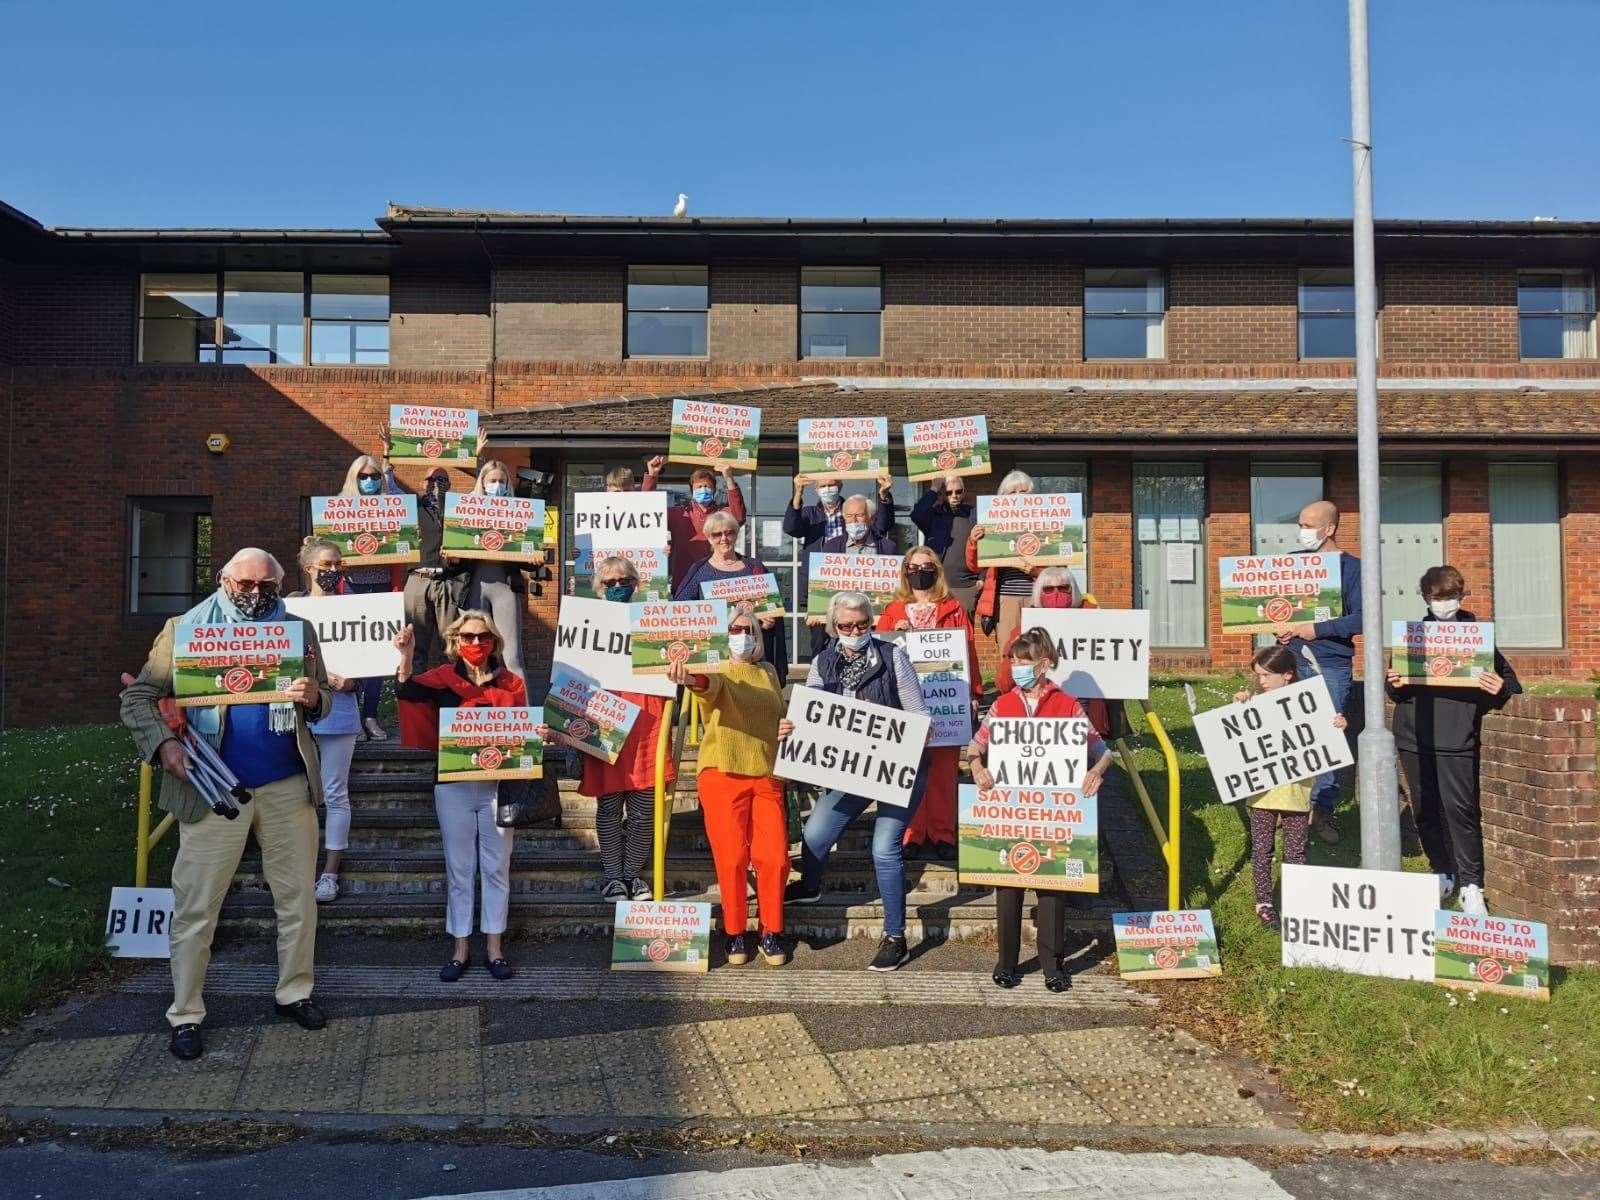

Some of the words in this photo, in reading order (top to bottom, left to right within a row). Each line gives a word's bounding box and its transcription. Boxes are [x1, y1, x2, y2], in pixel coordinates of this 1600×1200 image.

[404, 407, 426, 417] SAY
[430, 409, 447, 418] NO
[451, 410, 466, 419] TO
[687, 403, 709, 412] SAY
[712, 405, 730, 415] NO
[733, 407, 749, 417] TO
[400, 417, 469, 429] MONGEHAM
[681, 413, 752, 428] MONGEHAM
[811, 420, 833, 430] SAY
[838, 420, 855, 429] NO
[860, 419, 874, 428] TO
[916, 423, 937, 433] SAY
[940, 420, 956, 430] NO
[960, 418, 974, 427] TO
[404, 428, 463, 439] AIRFIELD!
[687, 425, 744, 438] AIRFIELD!
[808, 430, 878, 440] MONGEHAM
[912, 428, 979, 443] MONGEHAM
[815, 440, 873, 450] AIRFIELD!
[920, 438, 974, 453] AIRFIELD!
[327, 498, 354, 508] SAY
[360, 497, 379, 507] NO
[384, 497, 402, 506] TO
[460, 496, 486, 505] SAY
[490, 499, 509, 507] NO
[514, 500, 531, 509] TO
[991, 497, 1018, 507] SAY
[1023, 496, 1043, 506] NO
[1048, 495, 1066, 505] TO
[324, 508, 407, 520] MONGEHAM
[455, 506, 534, 520] MONGEHAM
[988, 508, 1072, 519] MONGEHAM
[333, 520, 401, 532] AIRFIELD!
[461, 518, 528, 531] AIRFIELD!
[996, 520, 1065, 532] AIRFIELD!
[588, 550, 612, 559] SAY
[616, 550, 634, 559] NO
[639, 550, 655, 559] TO
[824, 555, 850, 565] SAY
[855, 557, 876, 566] NO
[880, 558, 898, 567] TO
[1236, 558, 1266, 569] SAY
[1271, 557, 1295, 568] NO
[1300, 555, 1322, 566] TO
[1231, 569, 1328, 583] MONGEHAM
[827, 580, 895, 591] AIRFIELD!
[1241, 583, 1320, 596] AIRFIELD!
[643, 605, 668, 615] SAY
[673, 604, 691, 614] NO
[697, 603, 713, 613] TO
[640, 616, 718, 627] MONGEHAM
[194, 627, 226, 638] SAY
[233, 627, 257, 638] NO
[263, 625, 285, 636] TO
[319, 614, 402, 643] LUTiON
[1407, 624, 1432, 634] SAY
[1437, 625, 1456, 634] NO
[1461, 625, 1479, 634] TO
[920, 633, 952, 643] KEEP
[1403, 635, 1484, 645] MONGEHAM
[188, 639, 290, 653] MONGEHAM
[1056, 638, 1143, 661] AFETY
[199, 653, 282, 667] AIRFIELD!
[923, 648, 951, 659] OUR
[923, 671, 964, 683] RABLE
[568, 679, 592, 693] SAY
[592, 690, 609, 703] NO
[613, 698, 627, 711] TO
[923, 687, 957, 700] LAND
[560, 687, 626, 722] MONGEHAM
[455, 711, 482, 720] SAY
[487, 711, 506, 720] NO
[511, 710, 529, 720] TO
[1221, 707, 1263, 739] NO
[1276, 691, 1317, 720] TO
[451, 723, 533, 733] MONGEHAM
[806, 700, 906, 744] GREEN
[989, 720, 1087, 746] CHOCKS
[457, 735, 525, 746] AIRFIELD!
[1239, 723, 1315, 764] LEAD
[995, 758, 1079, 786] AWAY
[1224, 745, 1342, 798] PETROL
[978, 789, 1012, 803] SAY
[1019, 790, 1045, 804] NO
[1051, 791, 1077, 806] TO
[972, 805, 1082, 823] MONGEHAM
[981, 823, 1073, 841] AIRFIELD!
[1332, 882, 1376, 910] NO
[630, 904, 654, 913] SAY
[659, 904, 676, 914] NO
[681, 905, 697, 914] TO
[110, 897, 173, 935] BiR
[624, 916, 700, 926] MONGEHAM
[1127, 915, 1152, 926] SAY
[1156, 913, 1175, 923] NO
[1181, 913, 1197, 922] TO
[1125, 924, 1203, 936] MONGEHAM
[1451, 915, 1479, 927] SAY
[1484, 920, 1506, 931] NO
[1512, 923, 1531, 935] TO
[1446, 927, 1536, 948] MONGEHAM
[1455, 942, 1529, 962] AIRFIELD!
